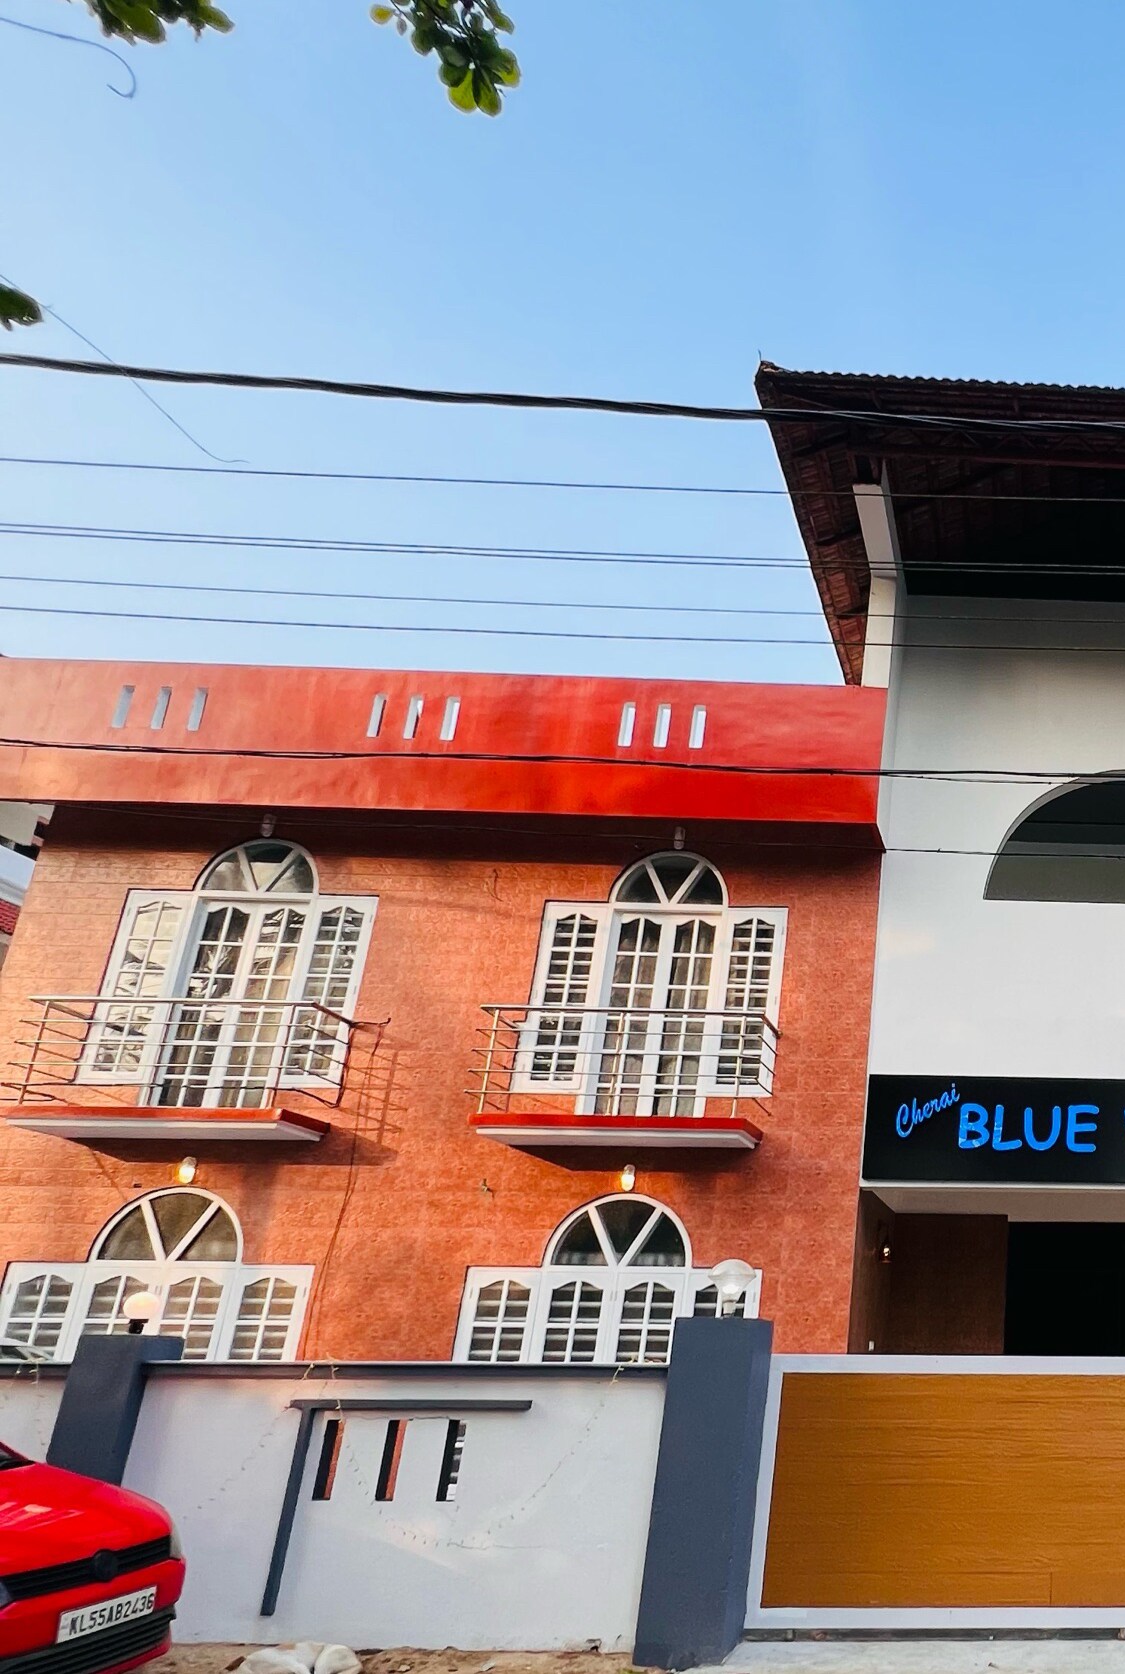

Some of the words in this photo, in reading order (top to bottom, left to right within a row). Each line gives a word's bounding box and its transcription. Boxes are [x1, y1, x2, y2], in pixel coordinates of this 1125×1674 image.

[896, 1083, 960, 1137] Cherai
[958, 1103, 1100, 1153] BLUE
[69, 1593, 154, 1635] KL55AB2436
